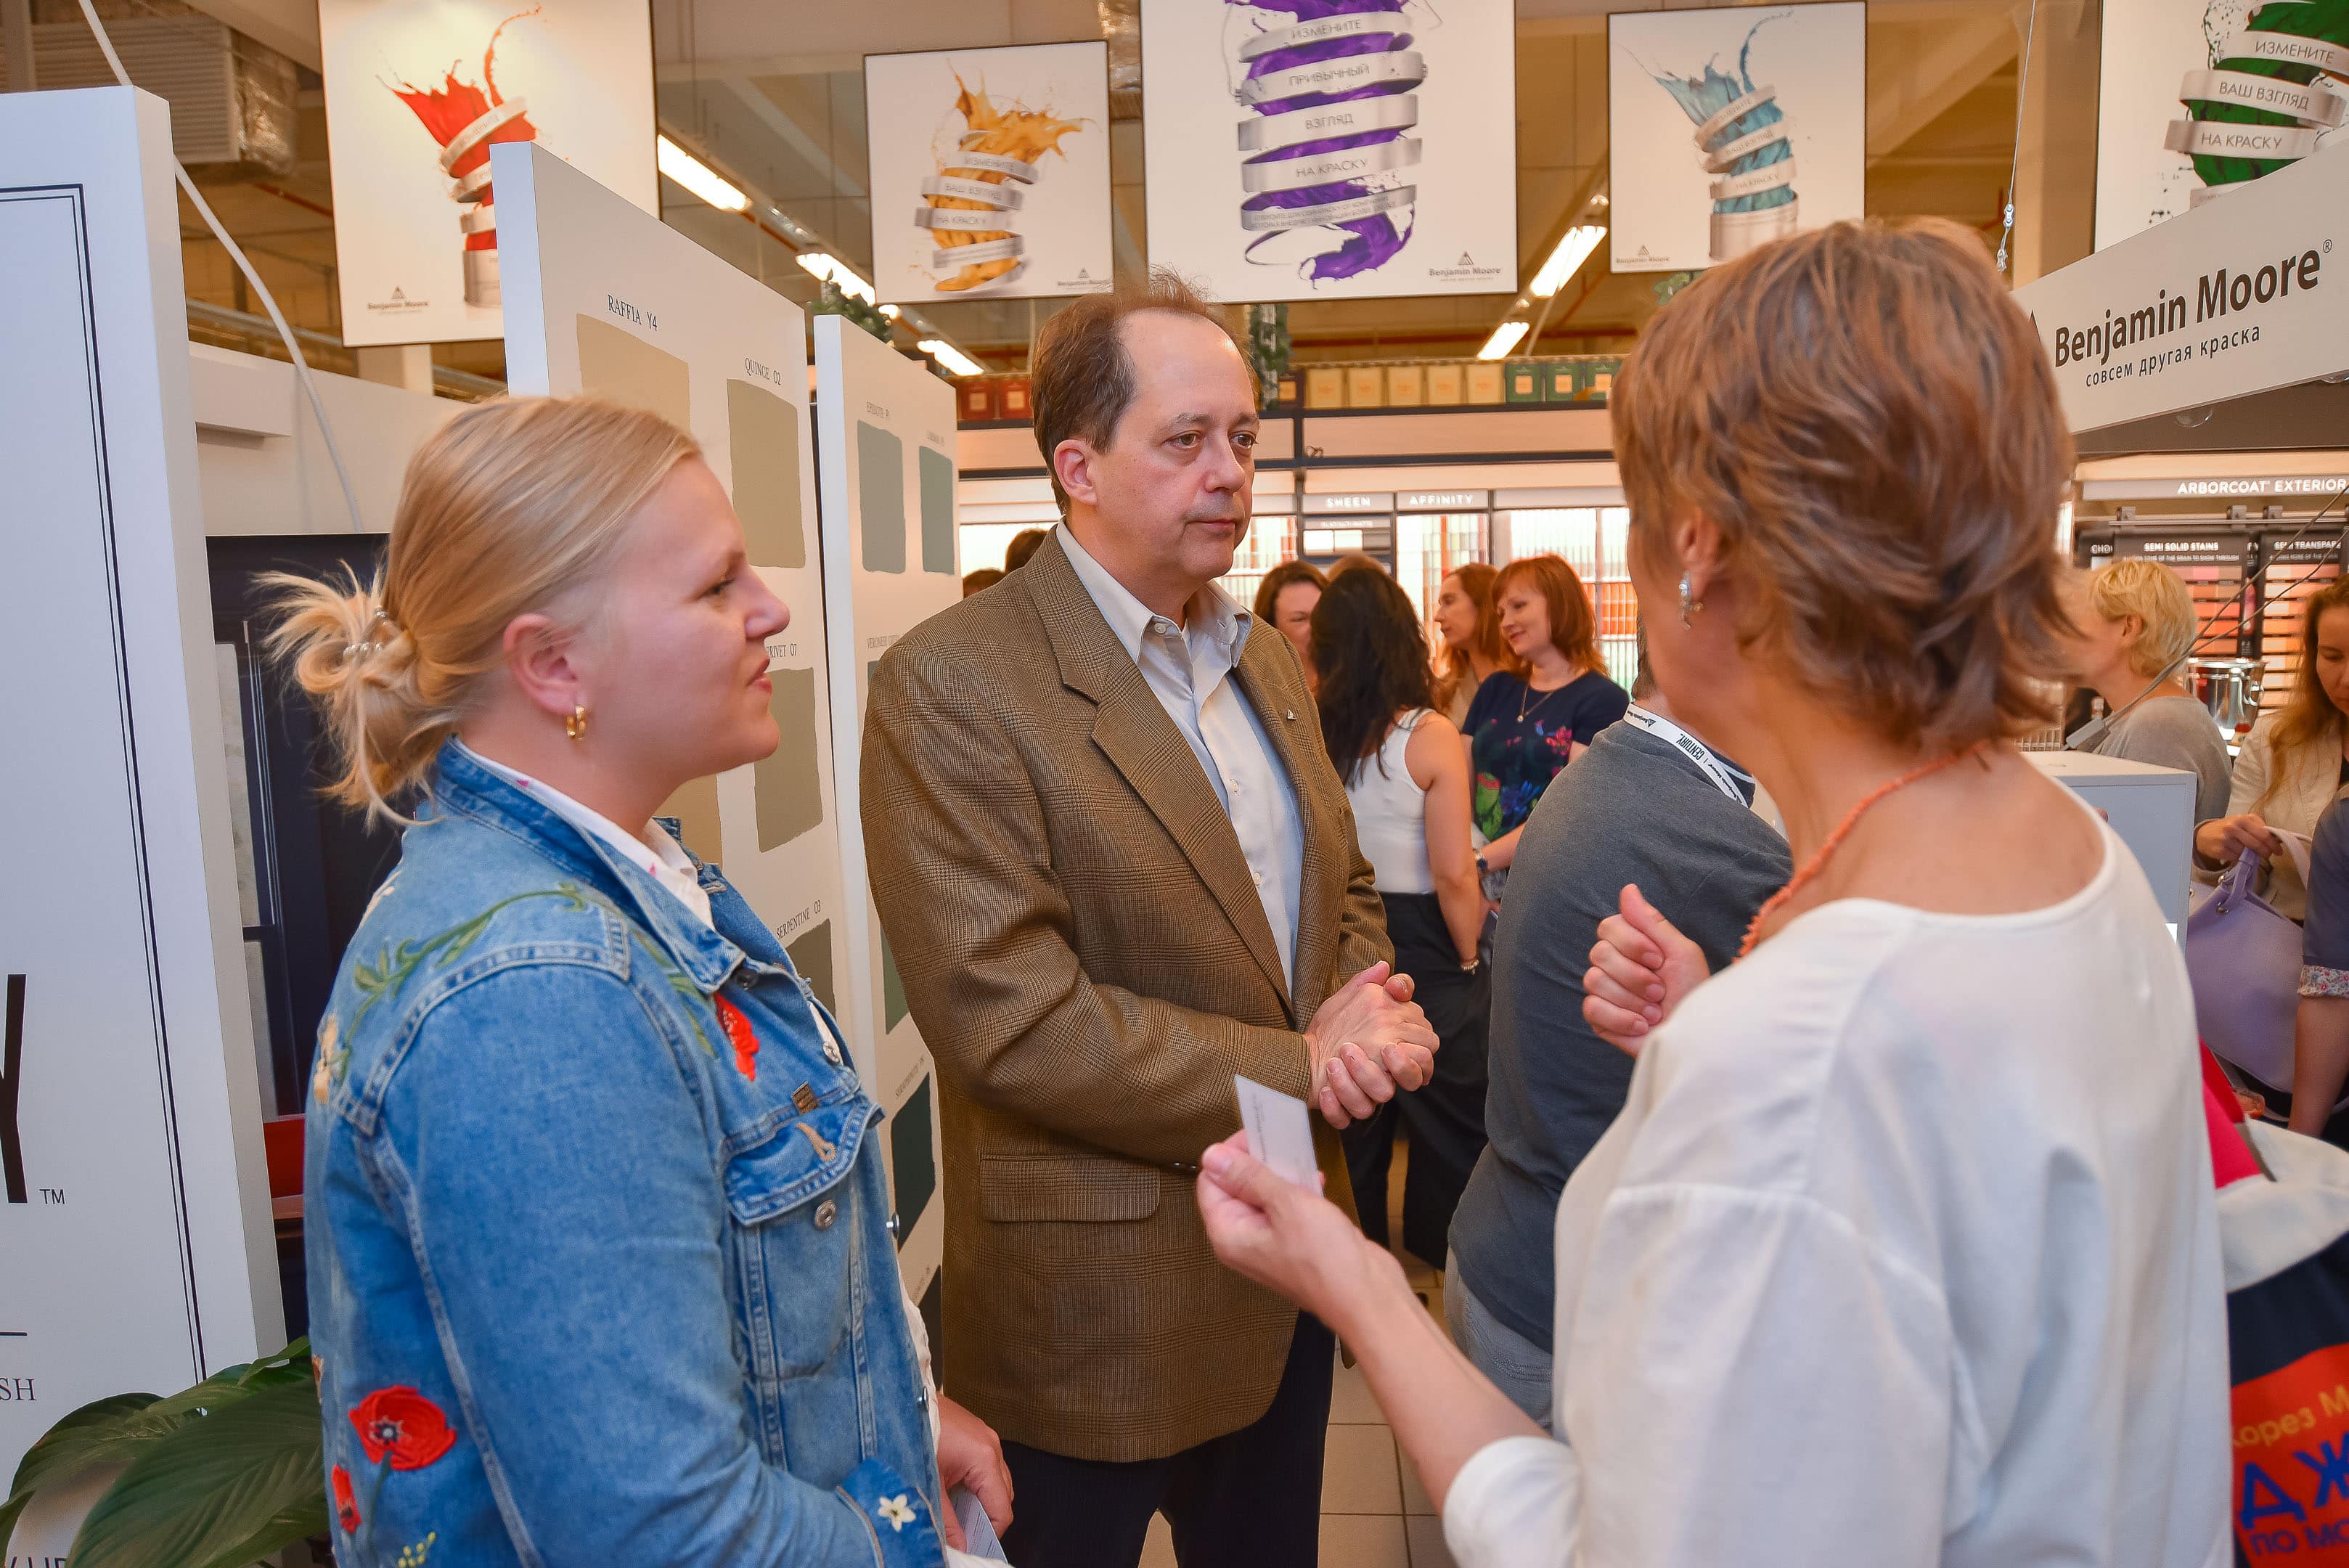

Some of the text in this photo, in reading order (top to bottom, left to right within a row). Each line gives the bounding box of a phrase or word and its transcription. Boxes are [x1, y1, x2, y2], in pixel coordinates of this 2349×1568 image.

[1291, 19, 1362, 38] ИЗМЕНИТЕ
[2254, 41, 2334, 64] ИЗМЕНИТЕ
[1288, 63, 1370, 86] ПРИВЫЧНЫЙ
[2219, 82, 2310, 110] ВАШ ВЗГЛЯД
[1305, 113, 1354, 130] ВЗГЛЯД
[2201, 133, 2283, 150] НА КРАСКУ
[1296, 158, 1368, 178] НА КРАСКУ
[1429, 268, 1471, 277] Benjamin
[607, 293, 658, 332] RAFFIA Y4
[2055, 288, 2186, 368] Benjamin
[2085, 324, 2260, 388] совсем другая краска
[745, 357, 770, 380] QUINCE
[2274, 478, 2348, 493] EXTERIOR
[1325, 497, 1371, 507] SHEEN
[1408, 494, 1474, 506] AFFINITY
[2144, 541, 2219, 552] SEMI SOLID STAINS
[776, 907, 810, 940] SERPENTINE
[39, 1188, 65, 1205] TM
[0, 1377, 37, 1402] SH
